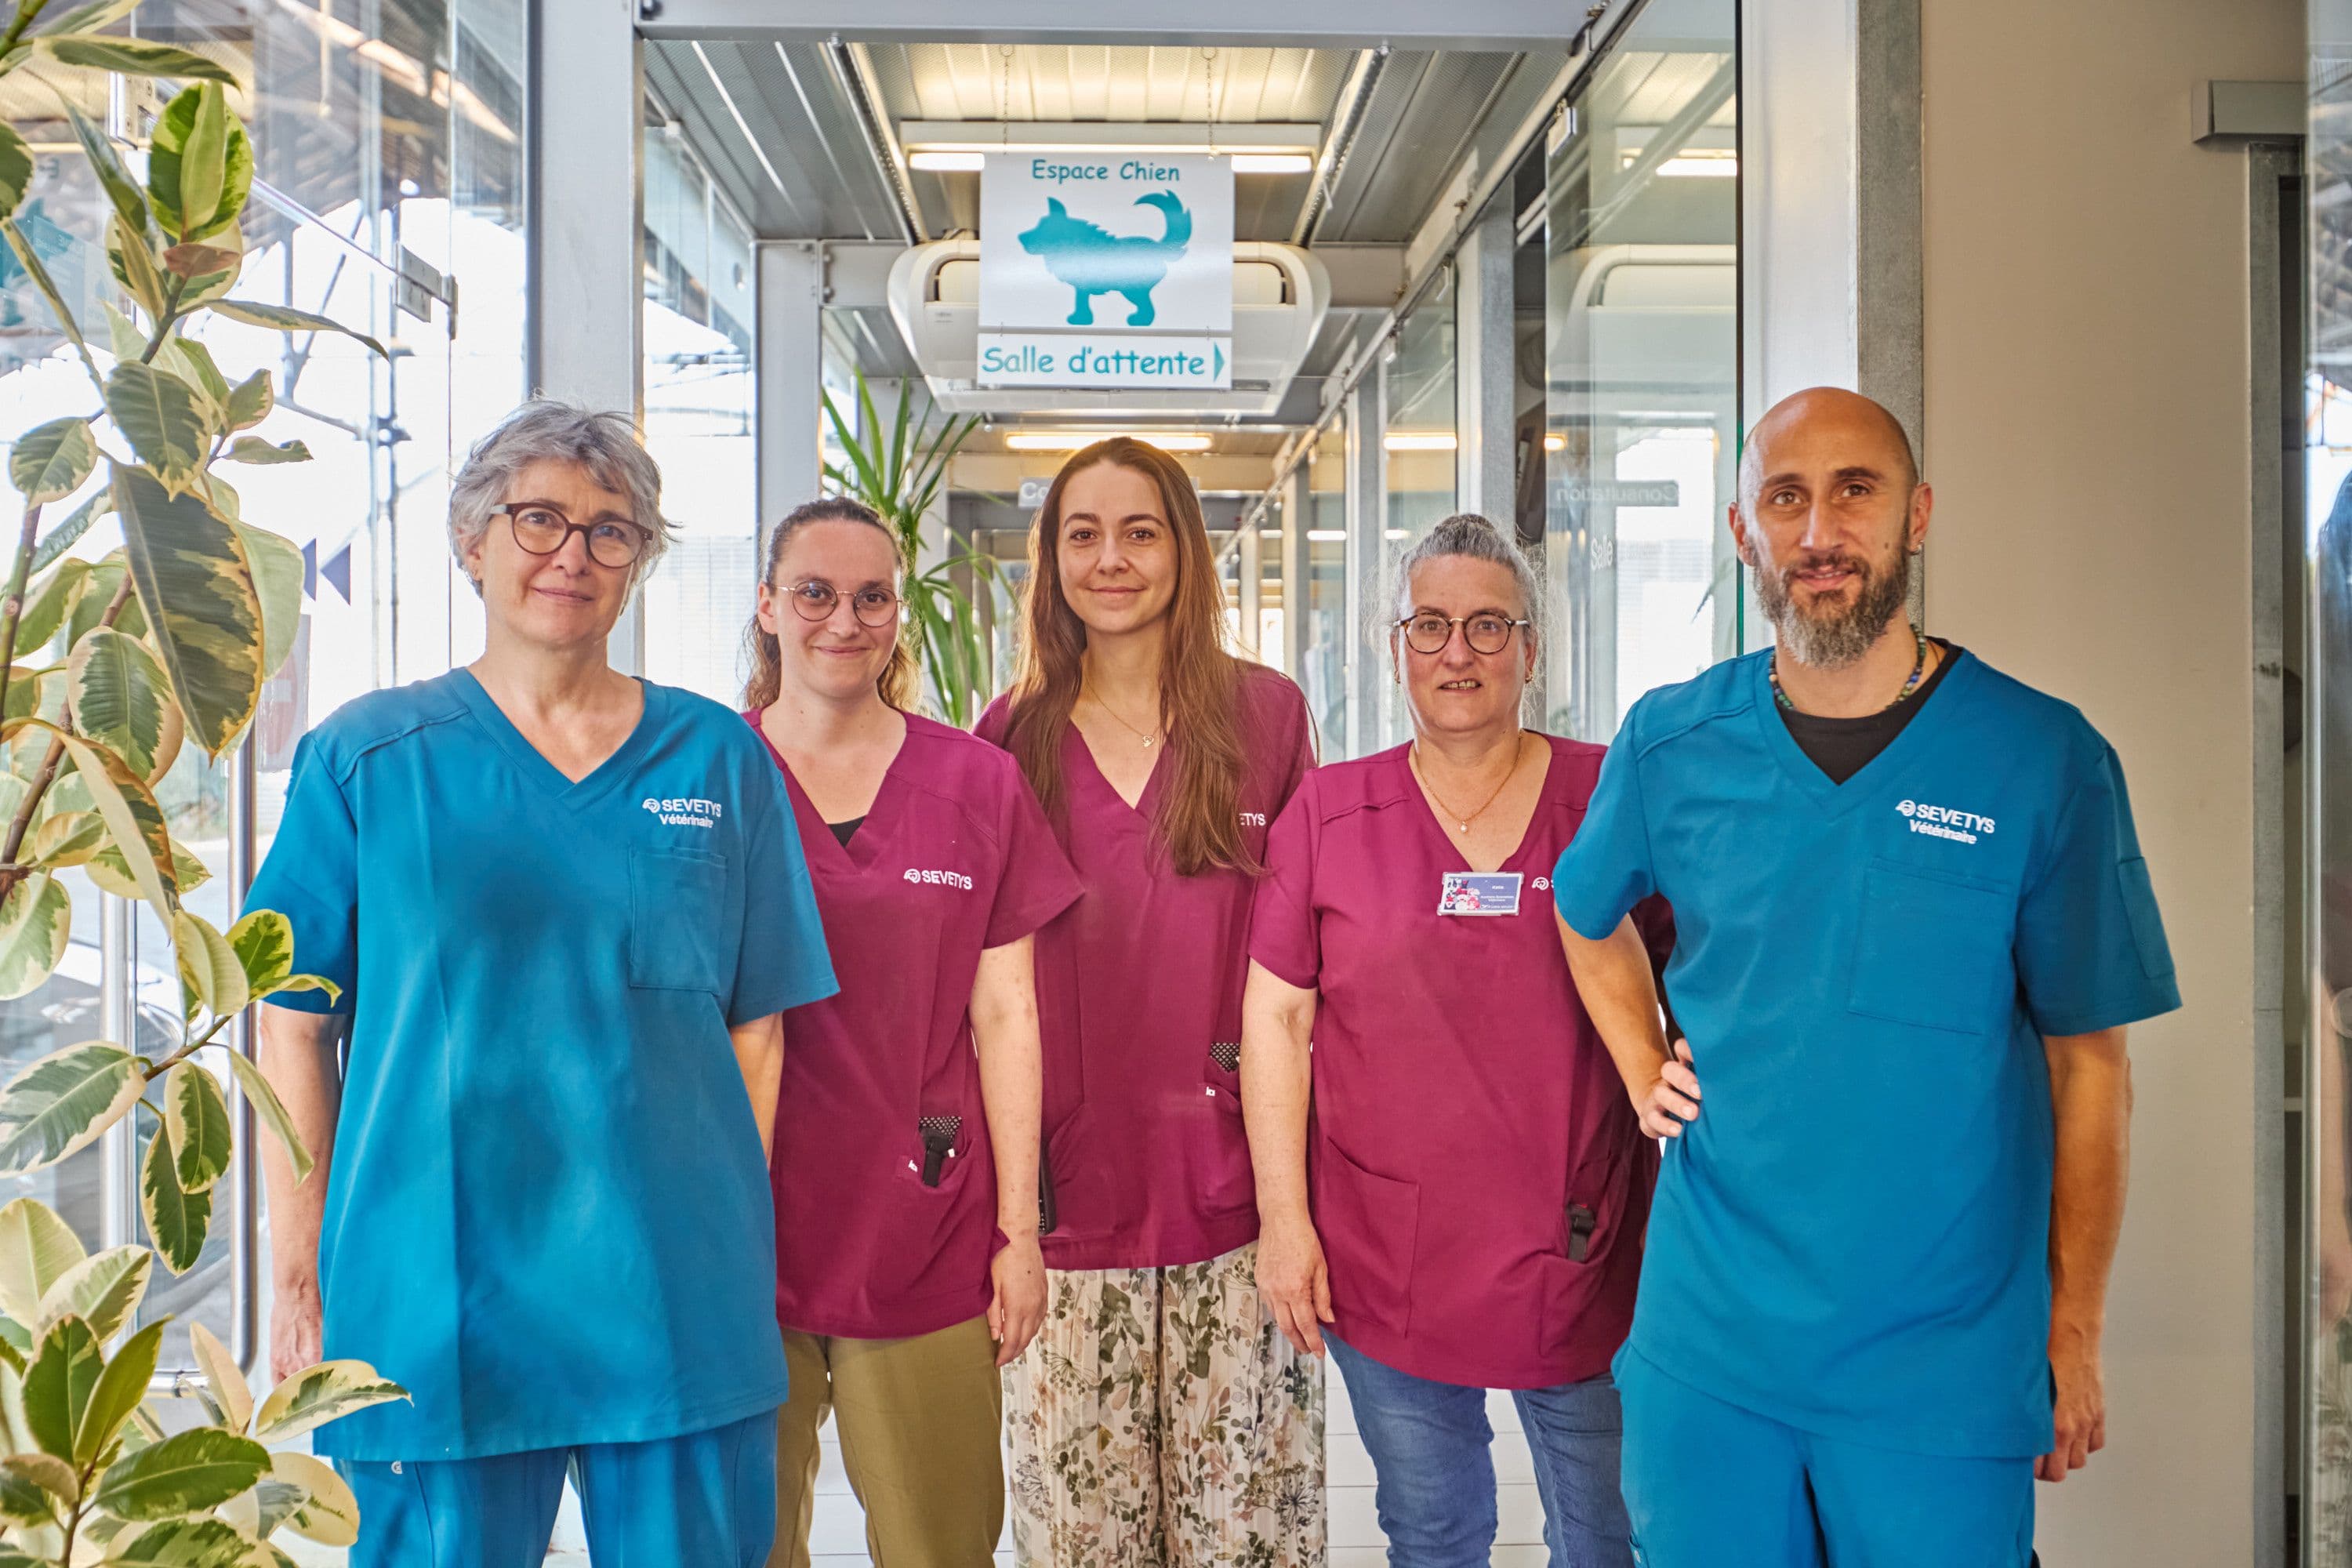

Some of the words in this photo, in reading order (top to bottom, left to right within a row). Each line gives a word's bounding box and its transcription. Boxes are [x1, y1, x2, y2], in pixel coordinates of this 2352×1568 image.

[1032, 158, 1109, 184] Espace
[1120, 161, 1180, 181] Chien
[982, 345, 1054, 373] Salle
[1069, 346, 1205, 375] d'attente
[662, 798, 721, 818] SEVETYS
[1916, 804, 1996, 834] SEVETYS
[921, 869, 973, 890] SEVETYS
